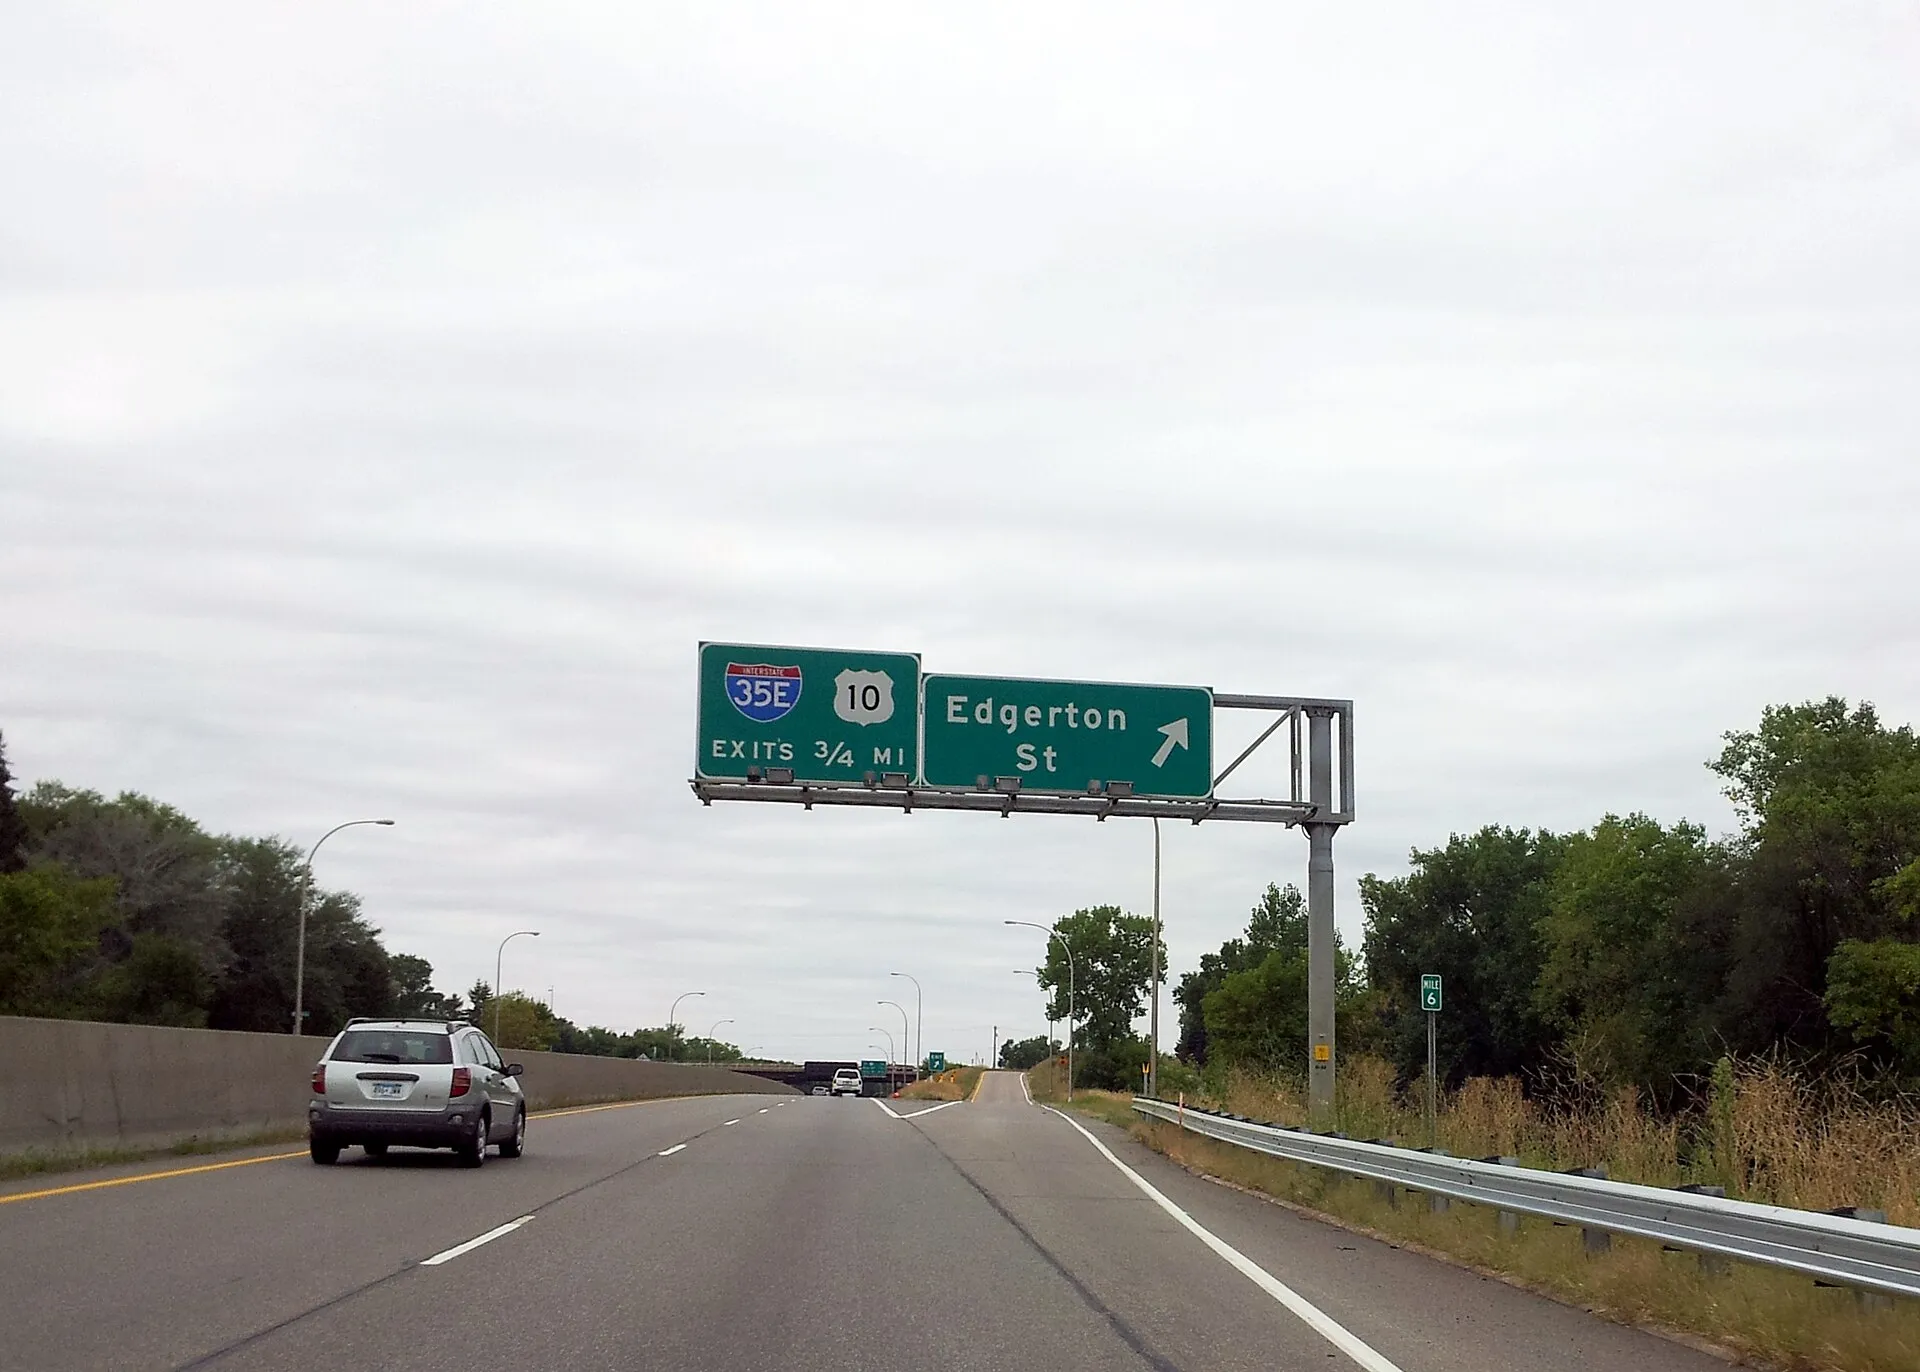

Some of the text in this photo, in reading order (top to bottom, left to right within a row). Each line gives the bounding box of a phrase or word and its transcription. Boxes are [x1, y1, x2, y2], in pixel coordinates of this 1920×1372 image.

[743, 667, 784, 676] INTERSTATE
[734, 679, 791, 707] 35E
[849, 684, 880, 711] 10
[947, 695, 1126, 734] Edgerton
[712, 740, 904, 767] EXITS 3/4 MI
[1016, 743, 1057, 772] St
[1423, 980, 1440, 989] MILE
[1427, 992, 1436, 1005] 6
